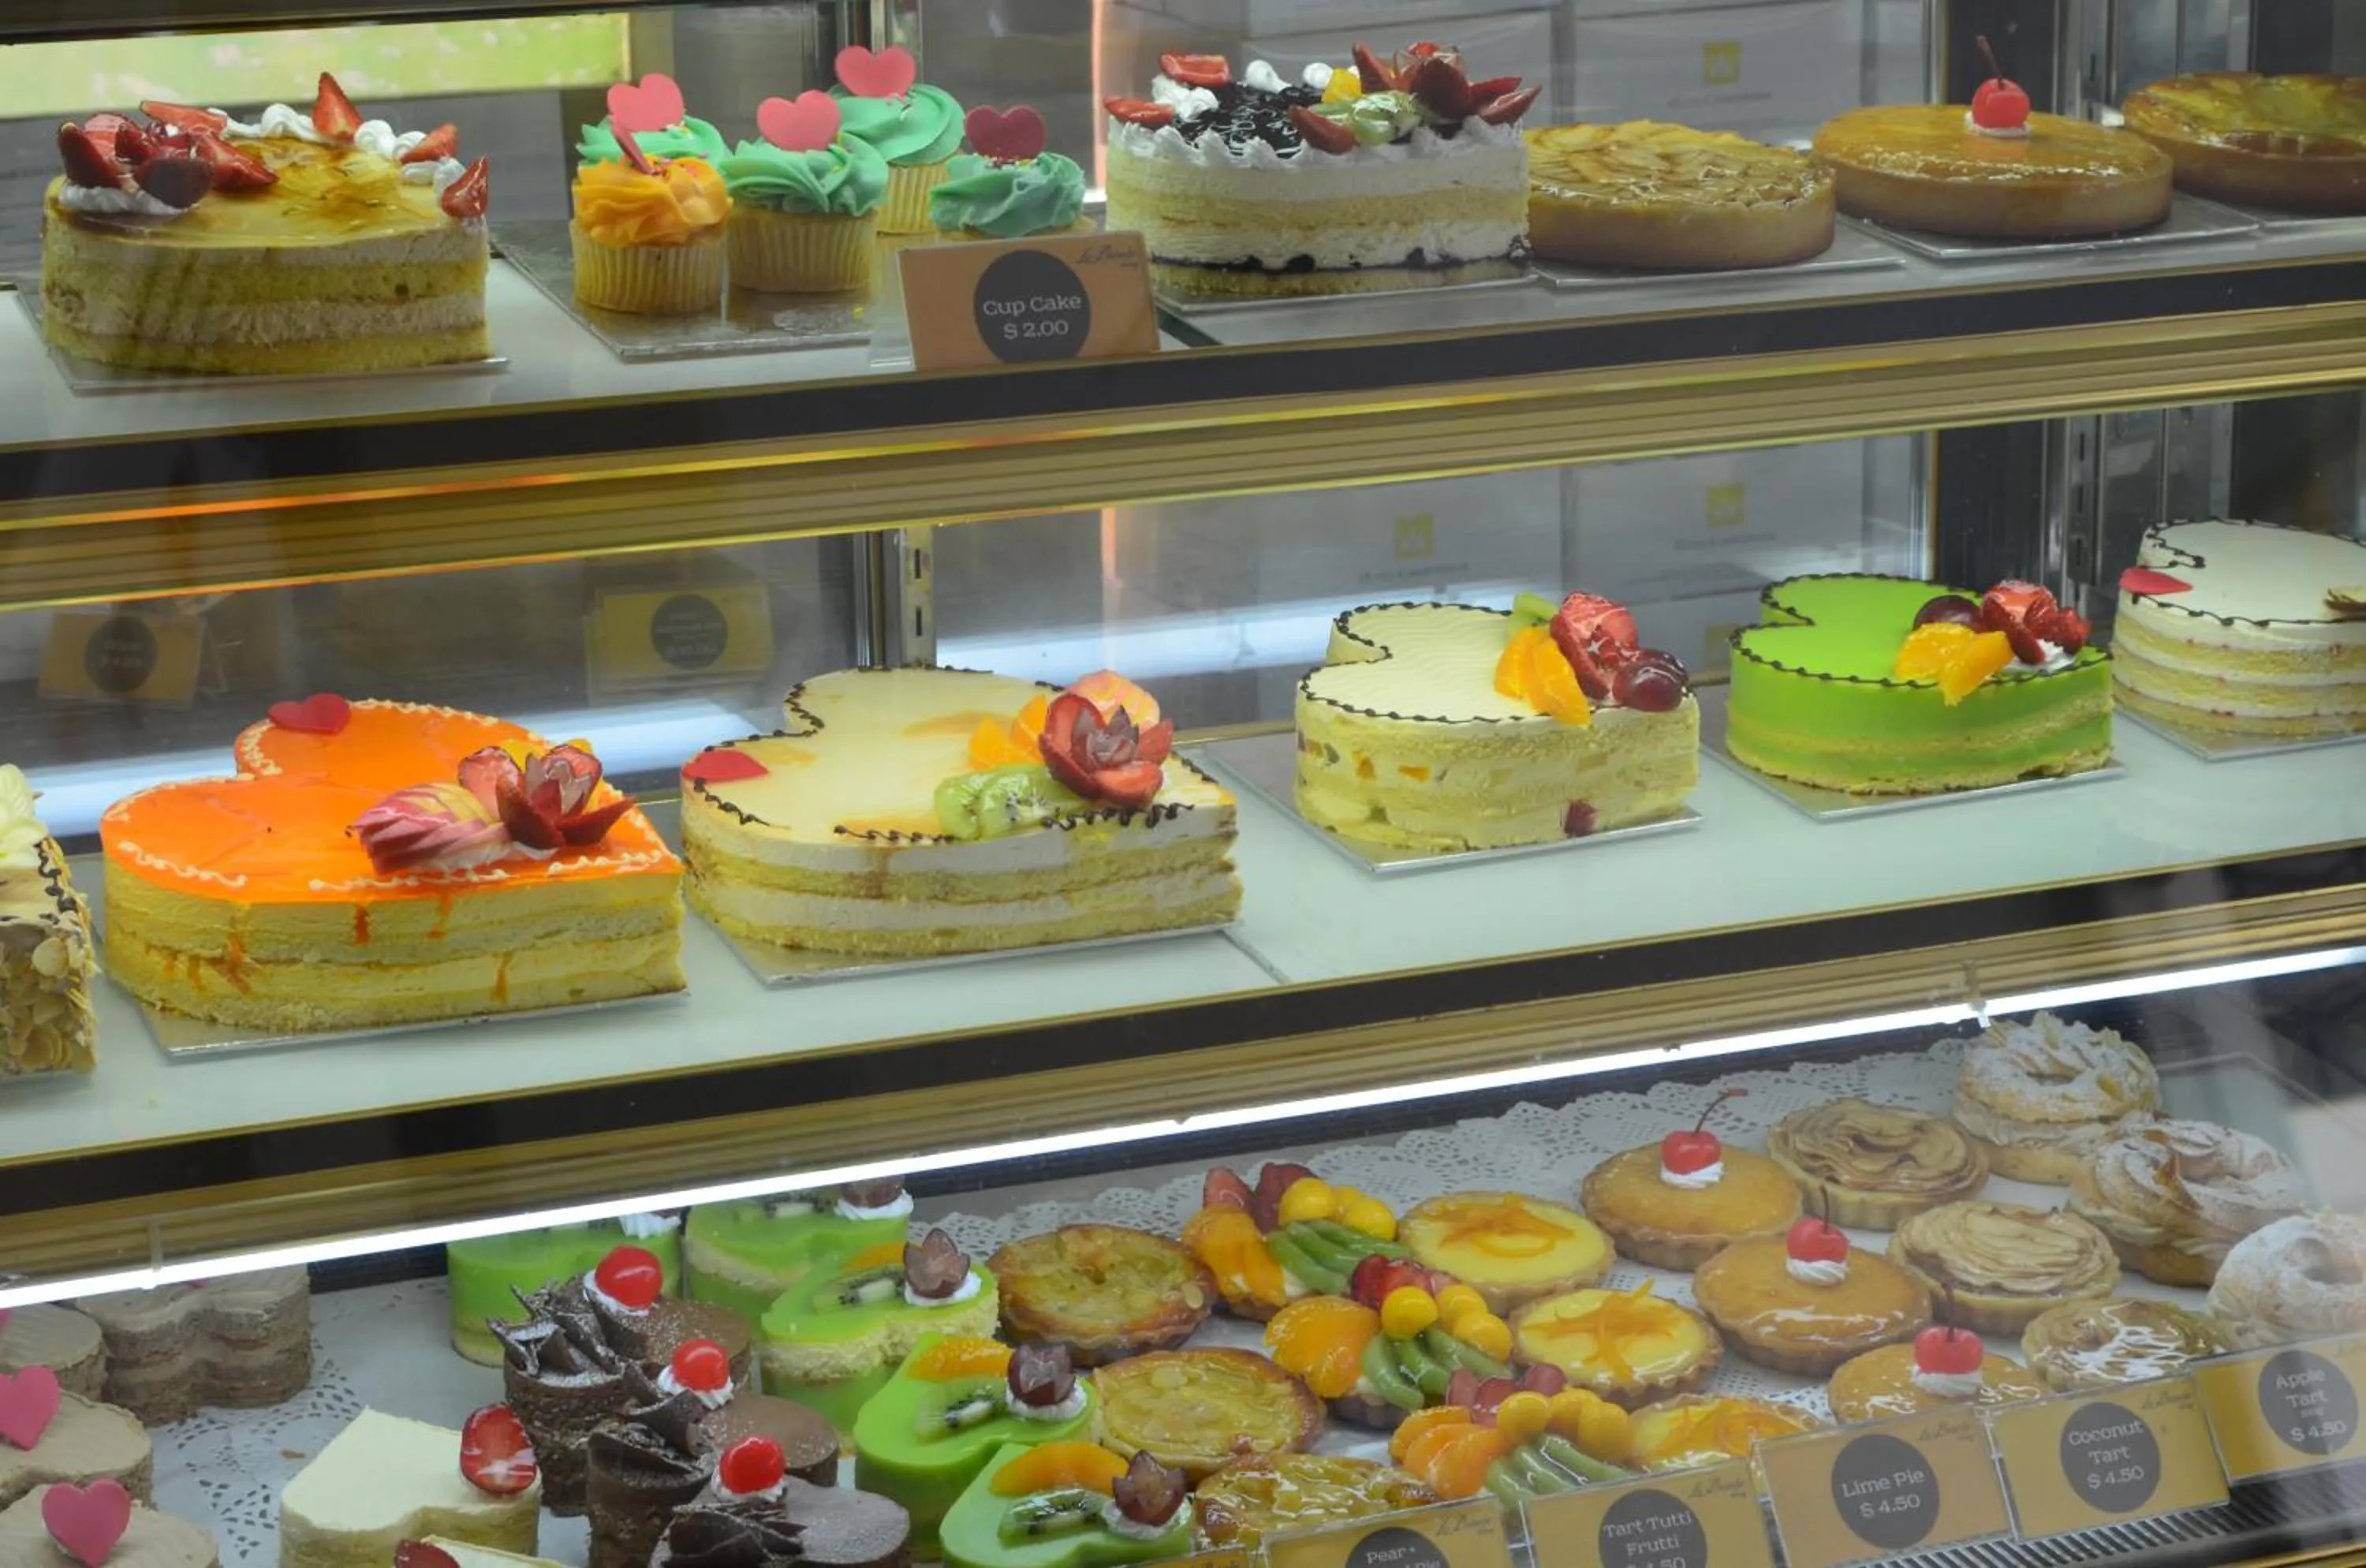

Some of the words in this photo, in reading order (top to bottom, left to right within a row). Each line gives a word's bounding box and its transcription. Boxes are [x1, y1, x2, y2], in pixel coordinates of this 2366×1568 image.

[983, 301, 1025, 316] Cup
[1030, 294, 1081, 312] Cake
[1023, 320, 1069, 338] 2.00
[2275, 1368, 2326, 1390] Apple
[2286, 1390, 2328, 1408] Tart
[2069, 1421, 2144, 1446] Coconut
[2308, 1420, 2346, 1439] 4.50
[2088, 1447, 2131, 1464] Tart
[1841, 1479, 1891, 1498] Lime
[1893, 1469, 1925, 1485] Pie
[2104, 1465, 2145, 1485] 4.50
[1879, 1494, 1920, 1514] 4.50
[1603, 1519, 1644, 1539] Tart
[1646, 1510, 1694, 1530] Tutti
[1626, 1534, 1680, 1557] Frutti
[1365, 1547, 1408, 1565] Pear
